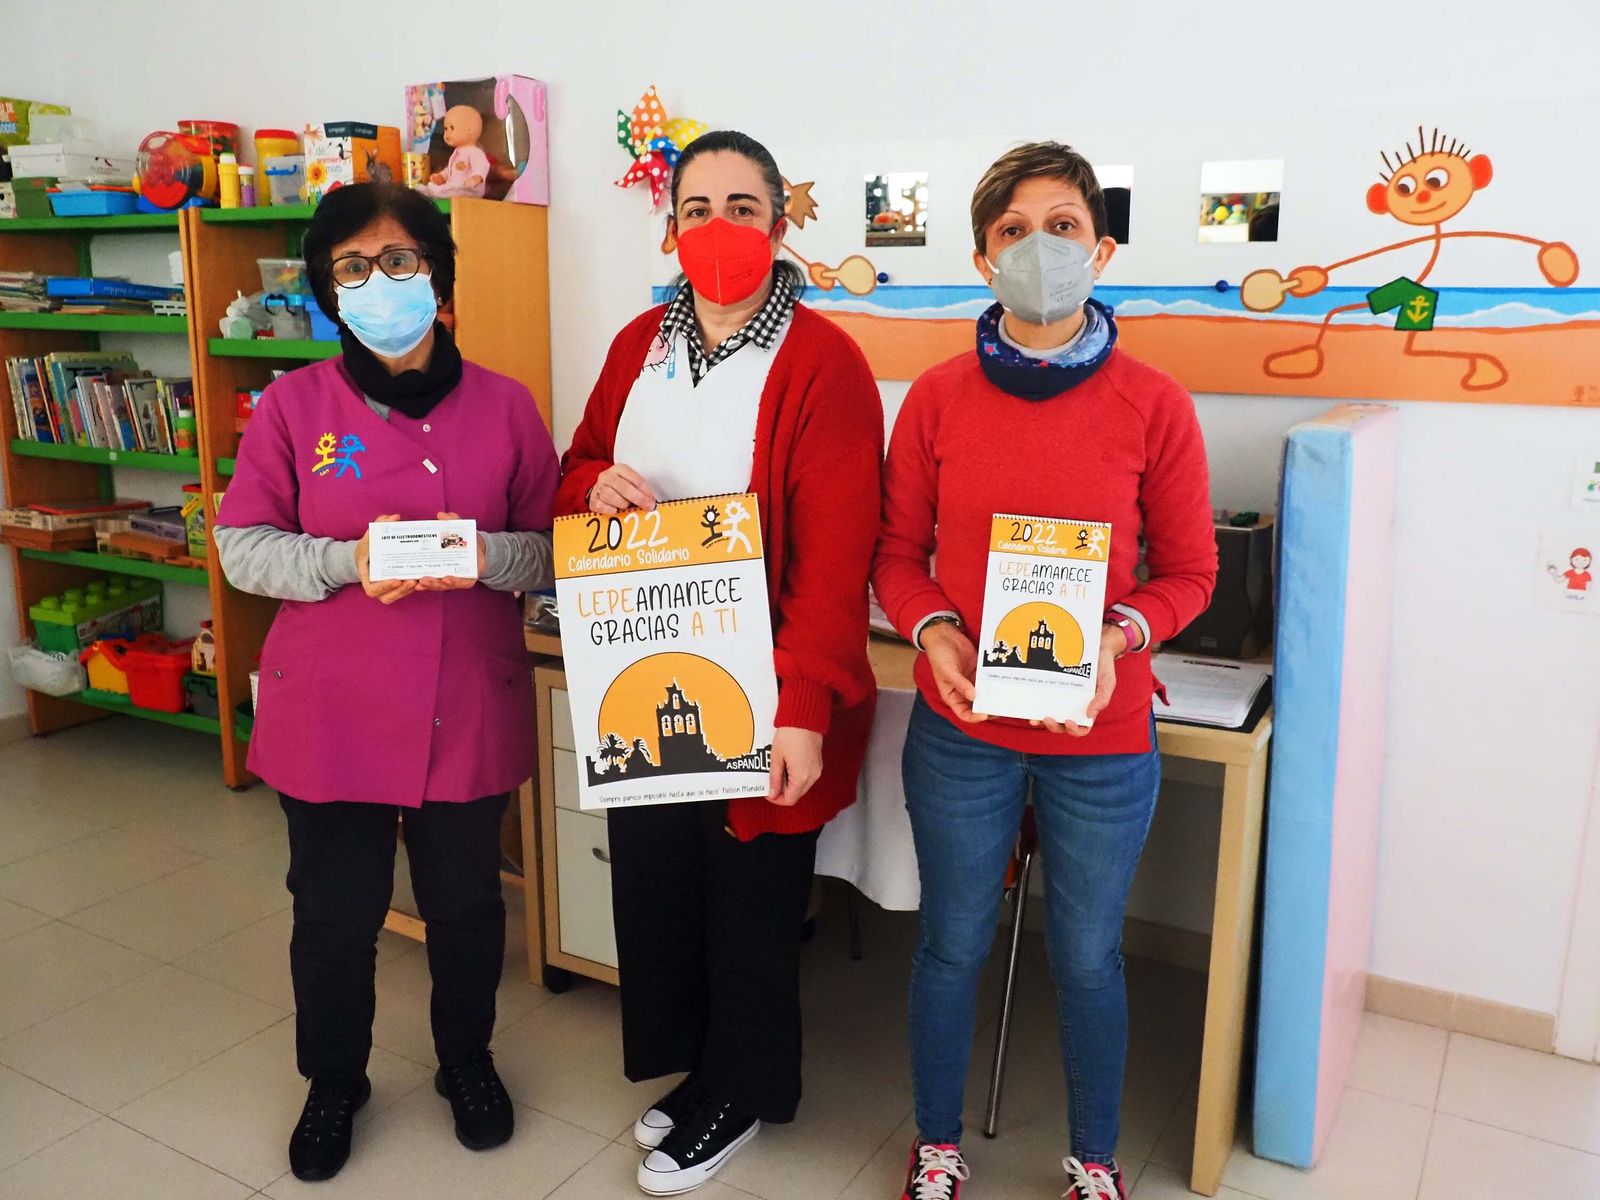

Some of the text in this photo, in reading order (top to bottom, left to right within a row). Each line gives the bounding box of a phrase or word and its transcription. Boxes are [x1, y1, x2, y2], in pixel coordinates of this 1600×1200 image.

[586, 510, 669, 553] 2022
[1011, 521, 1058, 545] 2022
[568, 546, 690, 573] Calendario Solidario
[997, 540, 1068, 555] Calendario Solidario
[1002, 577, 1088, 600] GRACIAS A TI
[590, 607, 738, 646] GRACIAS A TI
[726, 750, 771, 770] ASPANDLE
